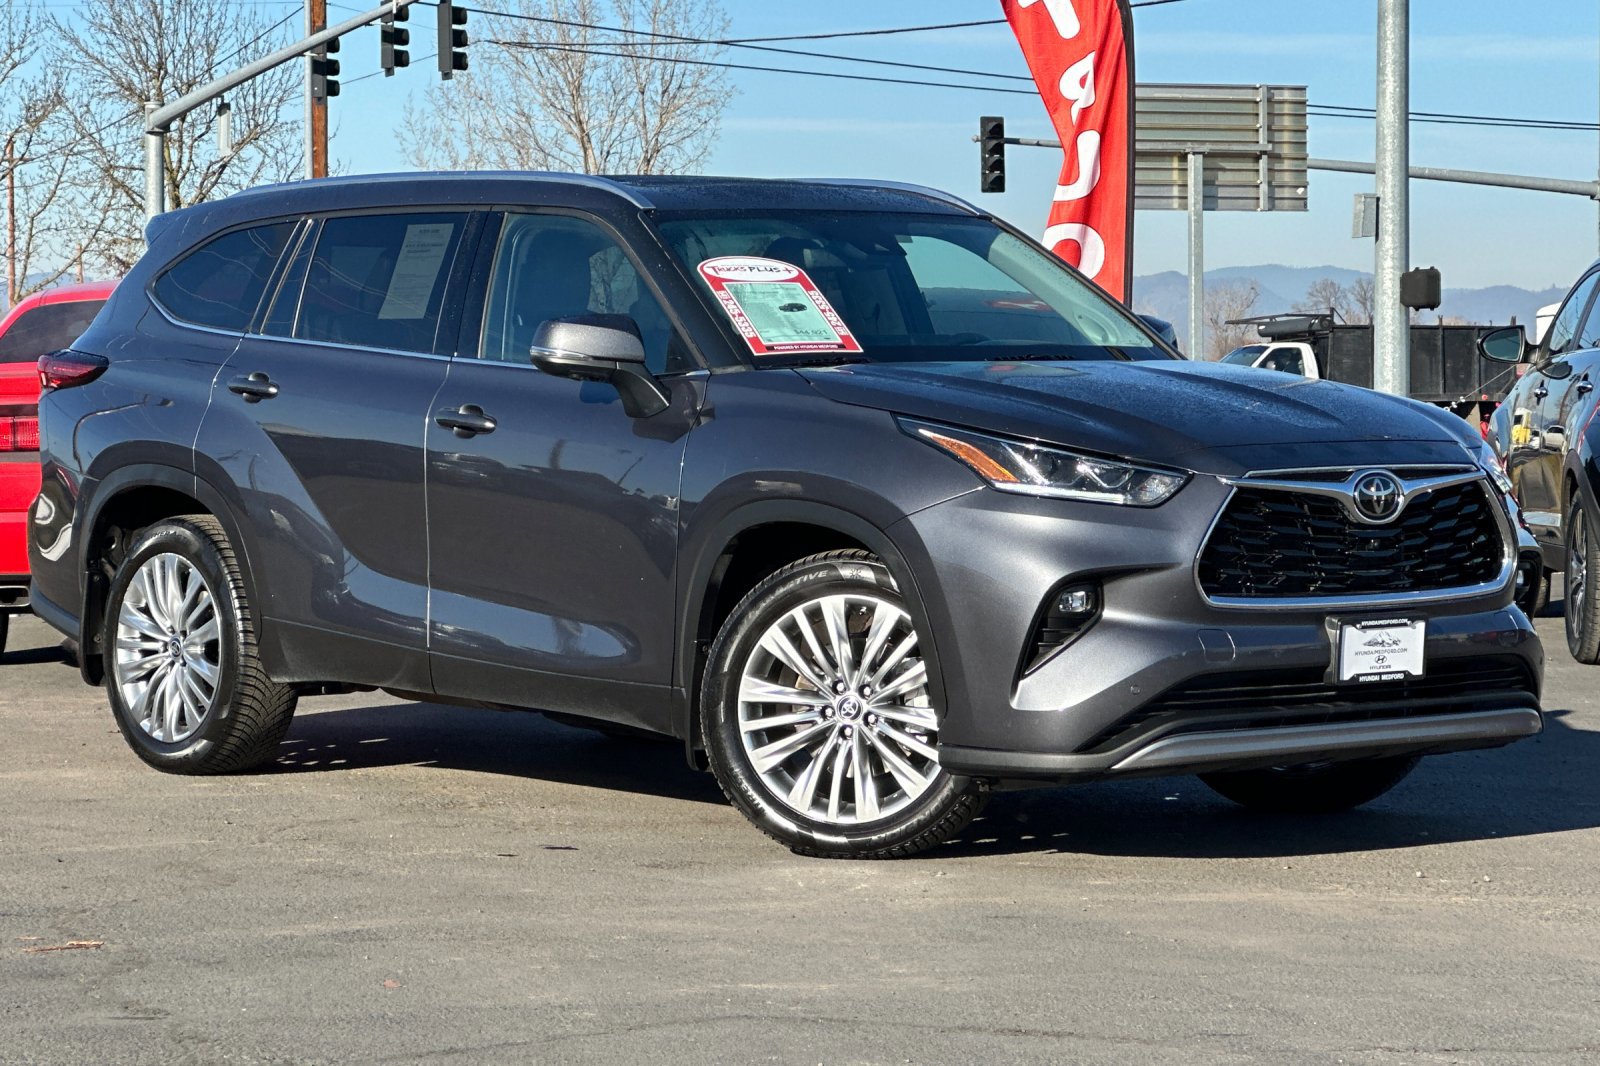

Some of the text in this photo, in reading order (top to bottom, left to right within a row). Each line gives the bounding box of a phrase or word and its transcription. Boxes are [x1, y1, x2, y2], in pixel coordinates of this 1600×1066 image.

[1355, 648, 1408, 656] HYUNDAIMEDFORD.COM
[1359, 673, 1405, 682] HYUNDAI MEDFORD
